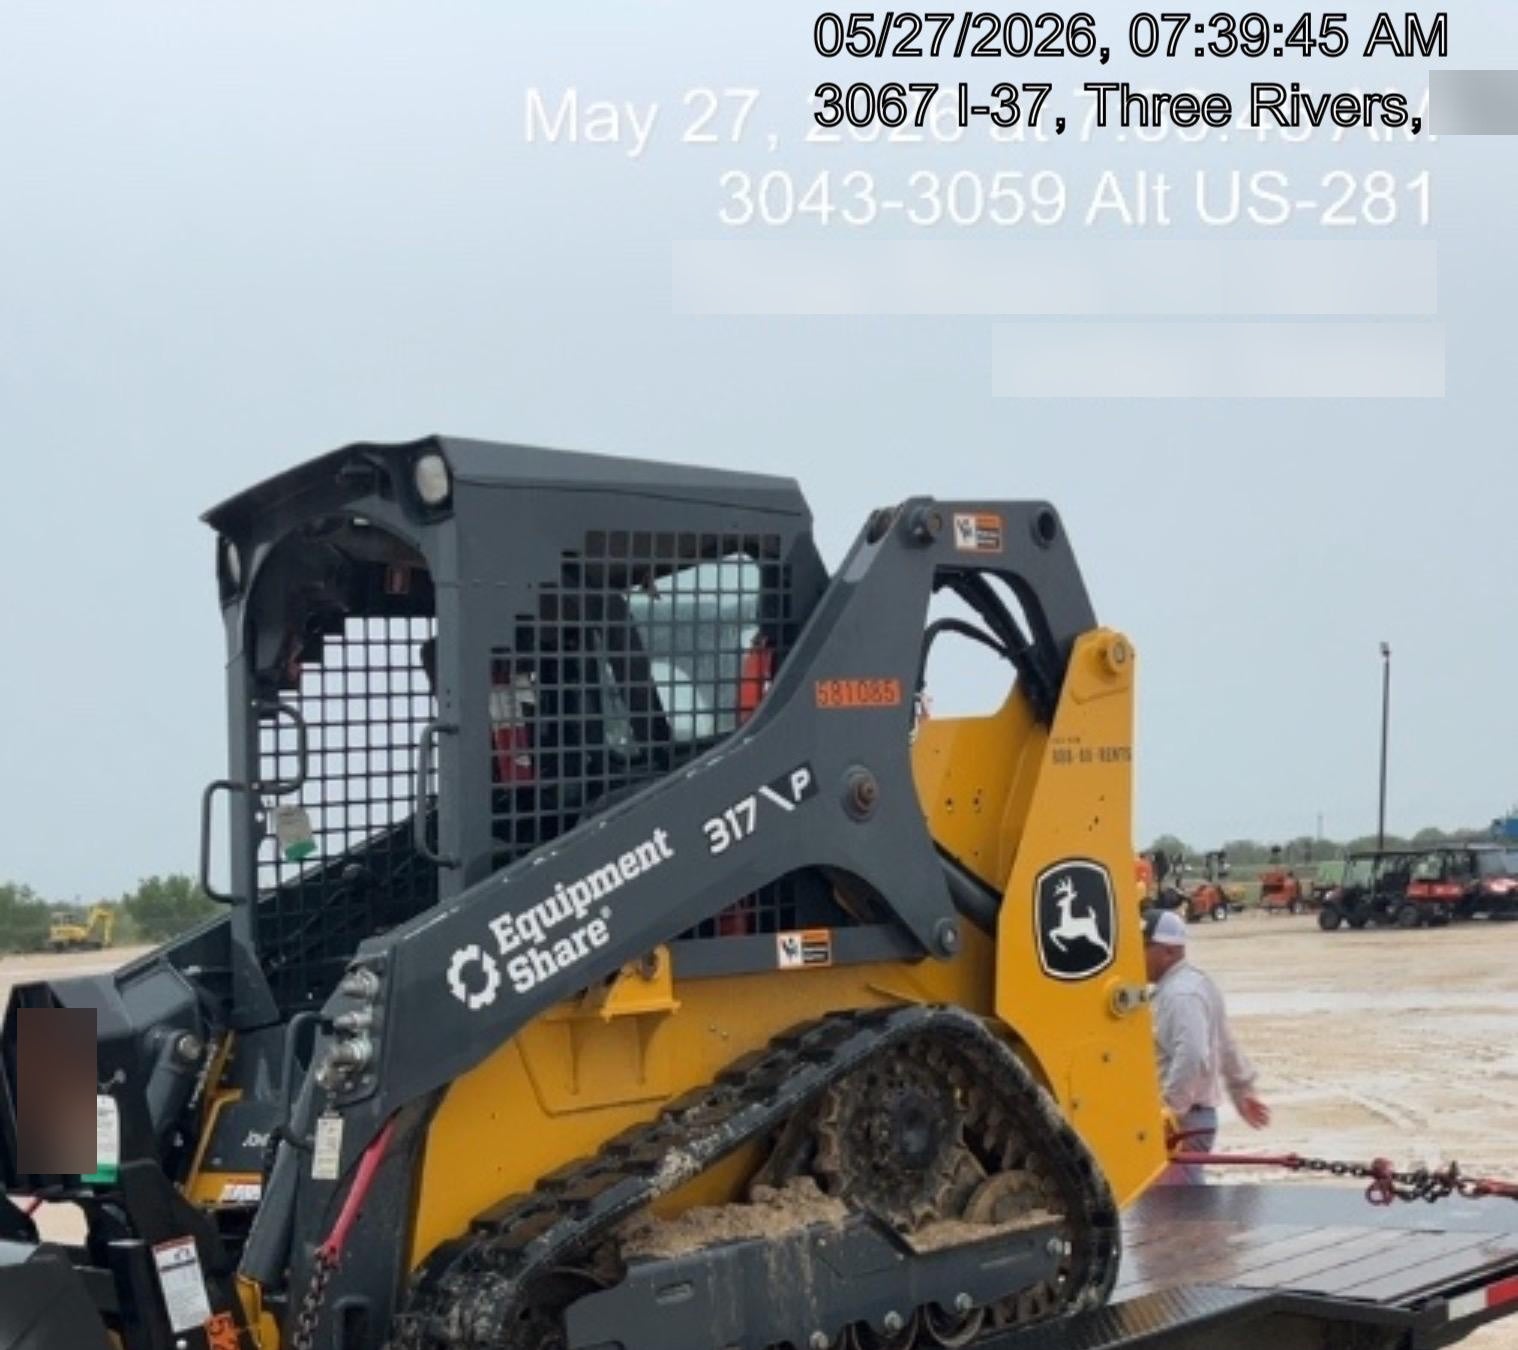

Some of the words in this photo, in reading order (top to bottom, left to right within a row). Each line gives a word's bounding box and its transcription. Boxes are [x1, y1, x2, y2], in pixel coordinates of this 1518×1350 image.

[703, 794, 757, 854] 317
[488, 827, 675, 955] Equipment
[506, 916, 611, 994] Share
